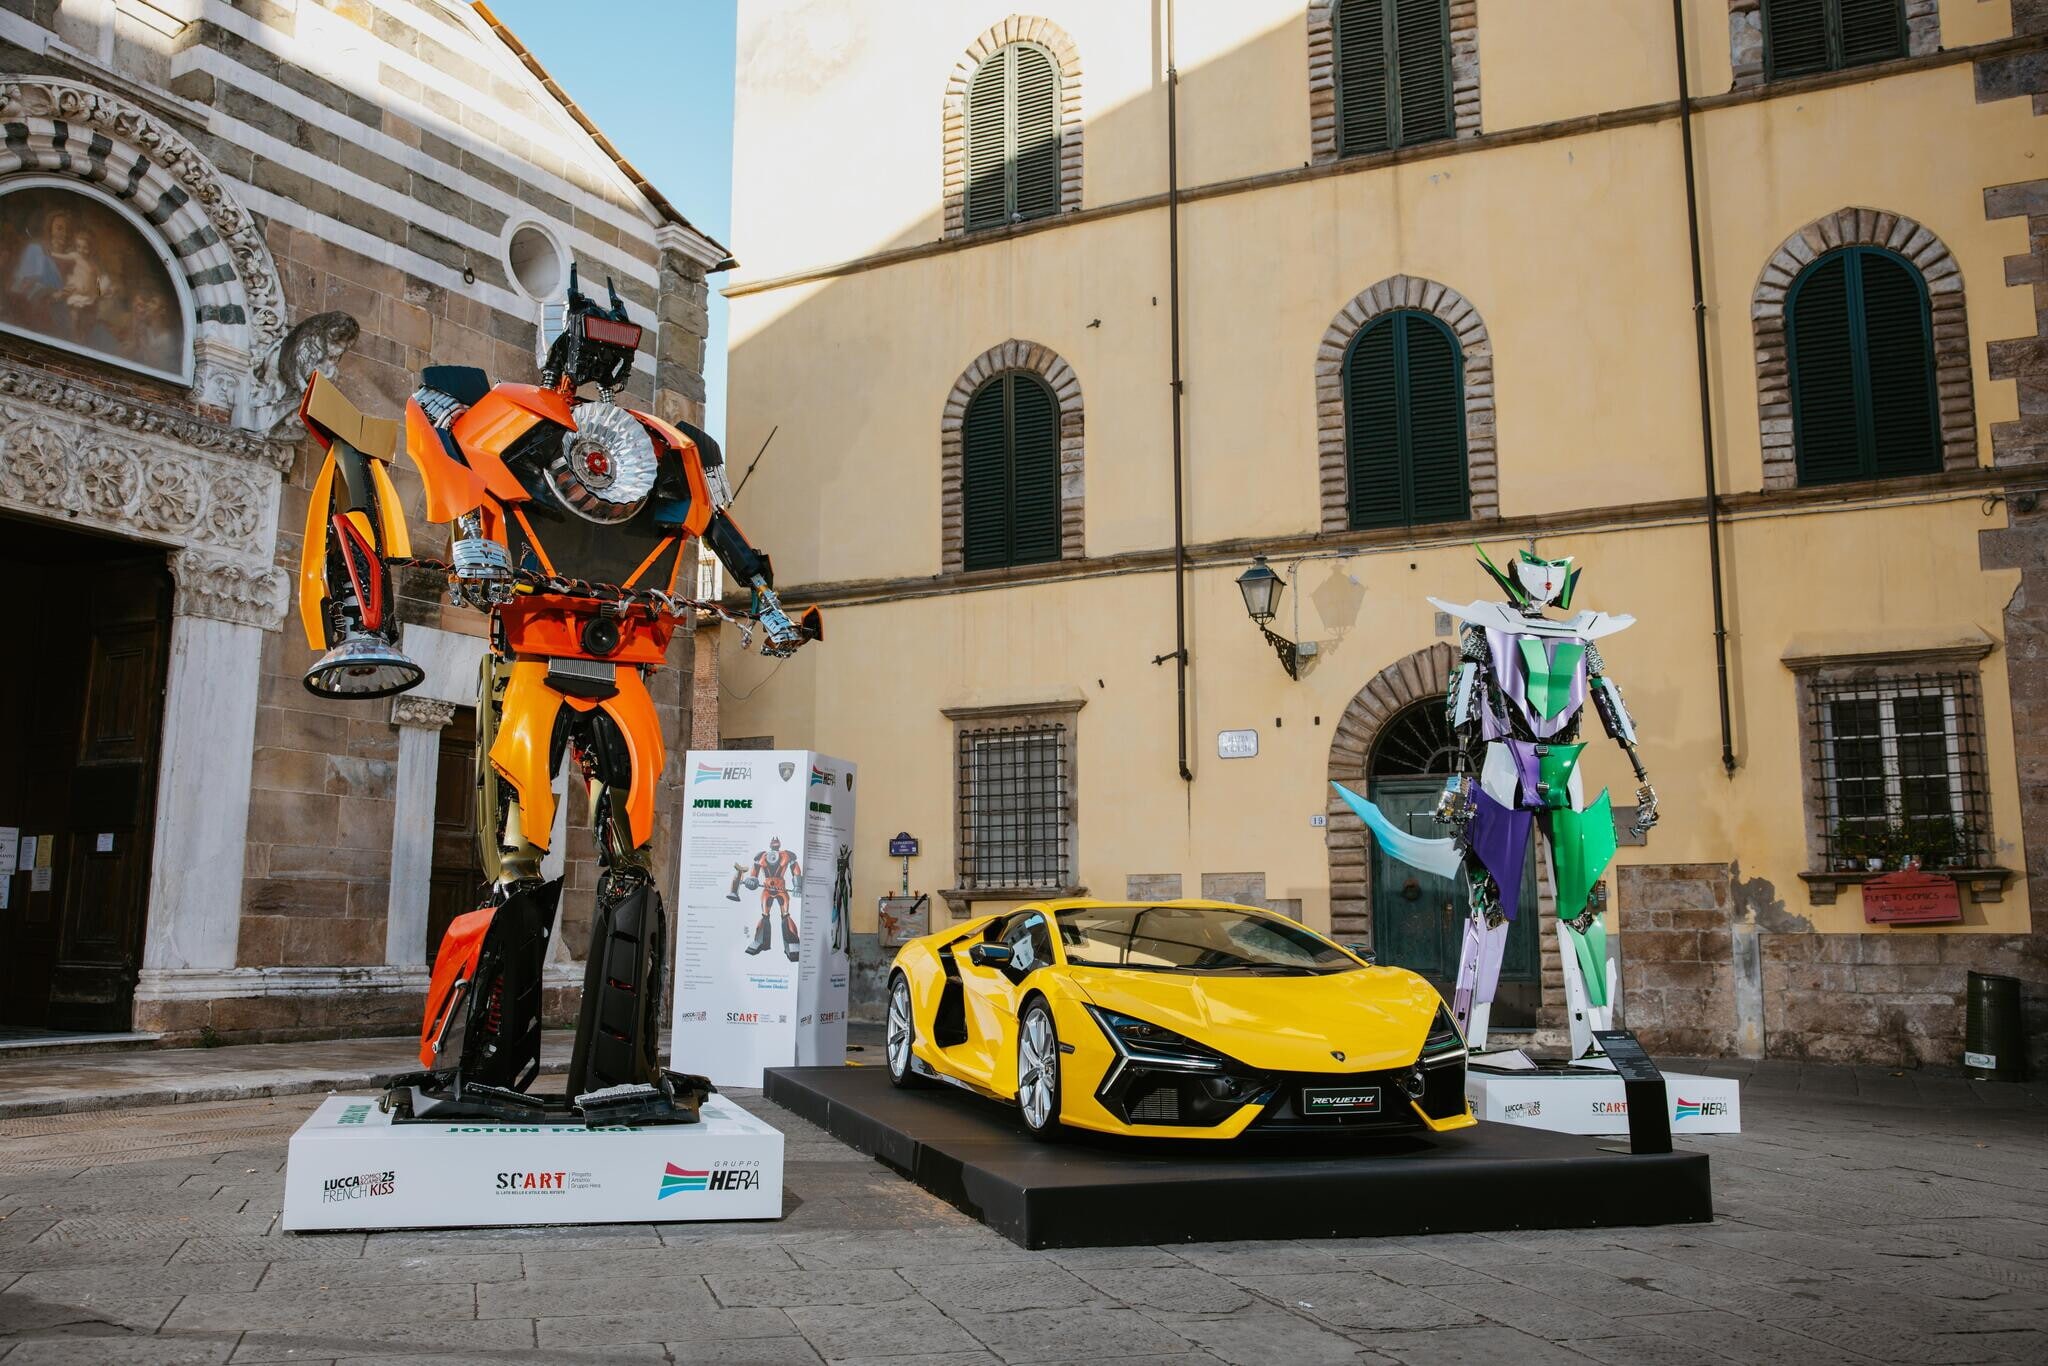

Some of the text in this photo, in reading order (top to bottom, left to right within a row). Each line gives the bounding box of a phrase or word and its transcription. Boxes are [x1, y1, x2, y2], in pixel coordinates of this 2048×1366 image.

[722, 767, 752, 780] HERA
[692, 799, 753, 809] JOTUN FORGE
[726, 1012, 759, 1022] SCART
[1312, 1095, 1375, 1104] REVUELTO
[1504, 1103, 1523, 1112] LUCCA
[1592, 1102, 1628, 1113] SCART
[1701, 1102, 1728, 1116] HERA
[324, 1176, 360, 1190] LUCCA
[381, 1171, 395, 1182] 25
[496, 1172, 567, 1189] SCART
[709, 1169, 760, 1190] HERA
[322, 1182, 394, 1204] FRENCH KISS
